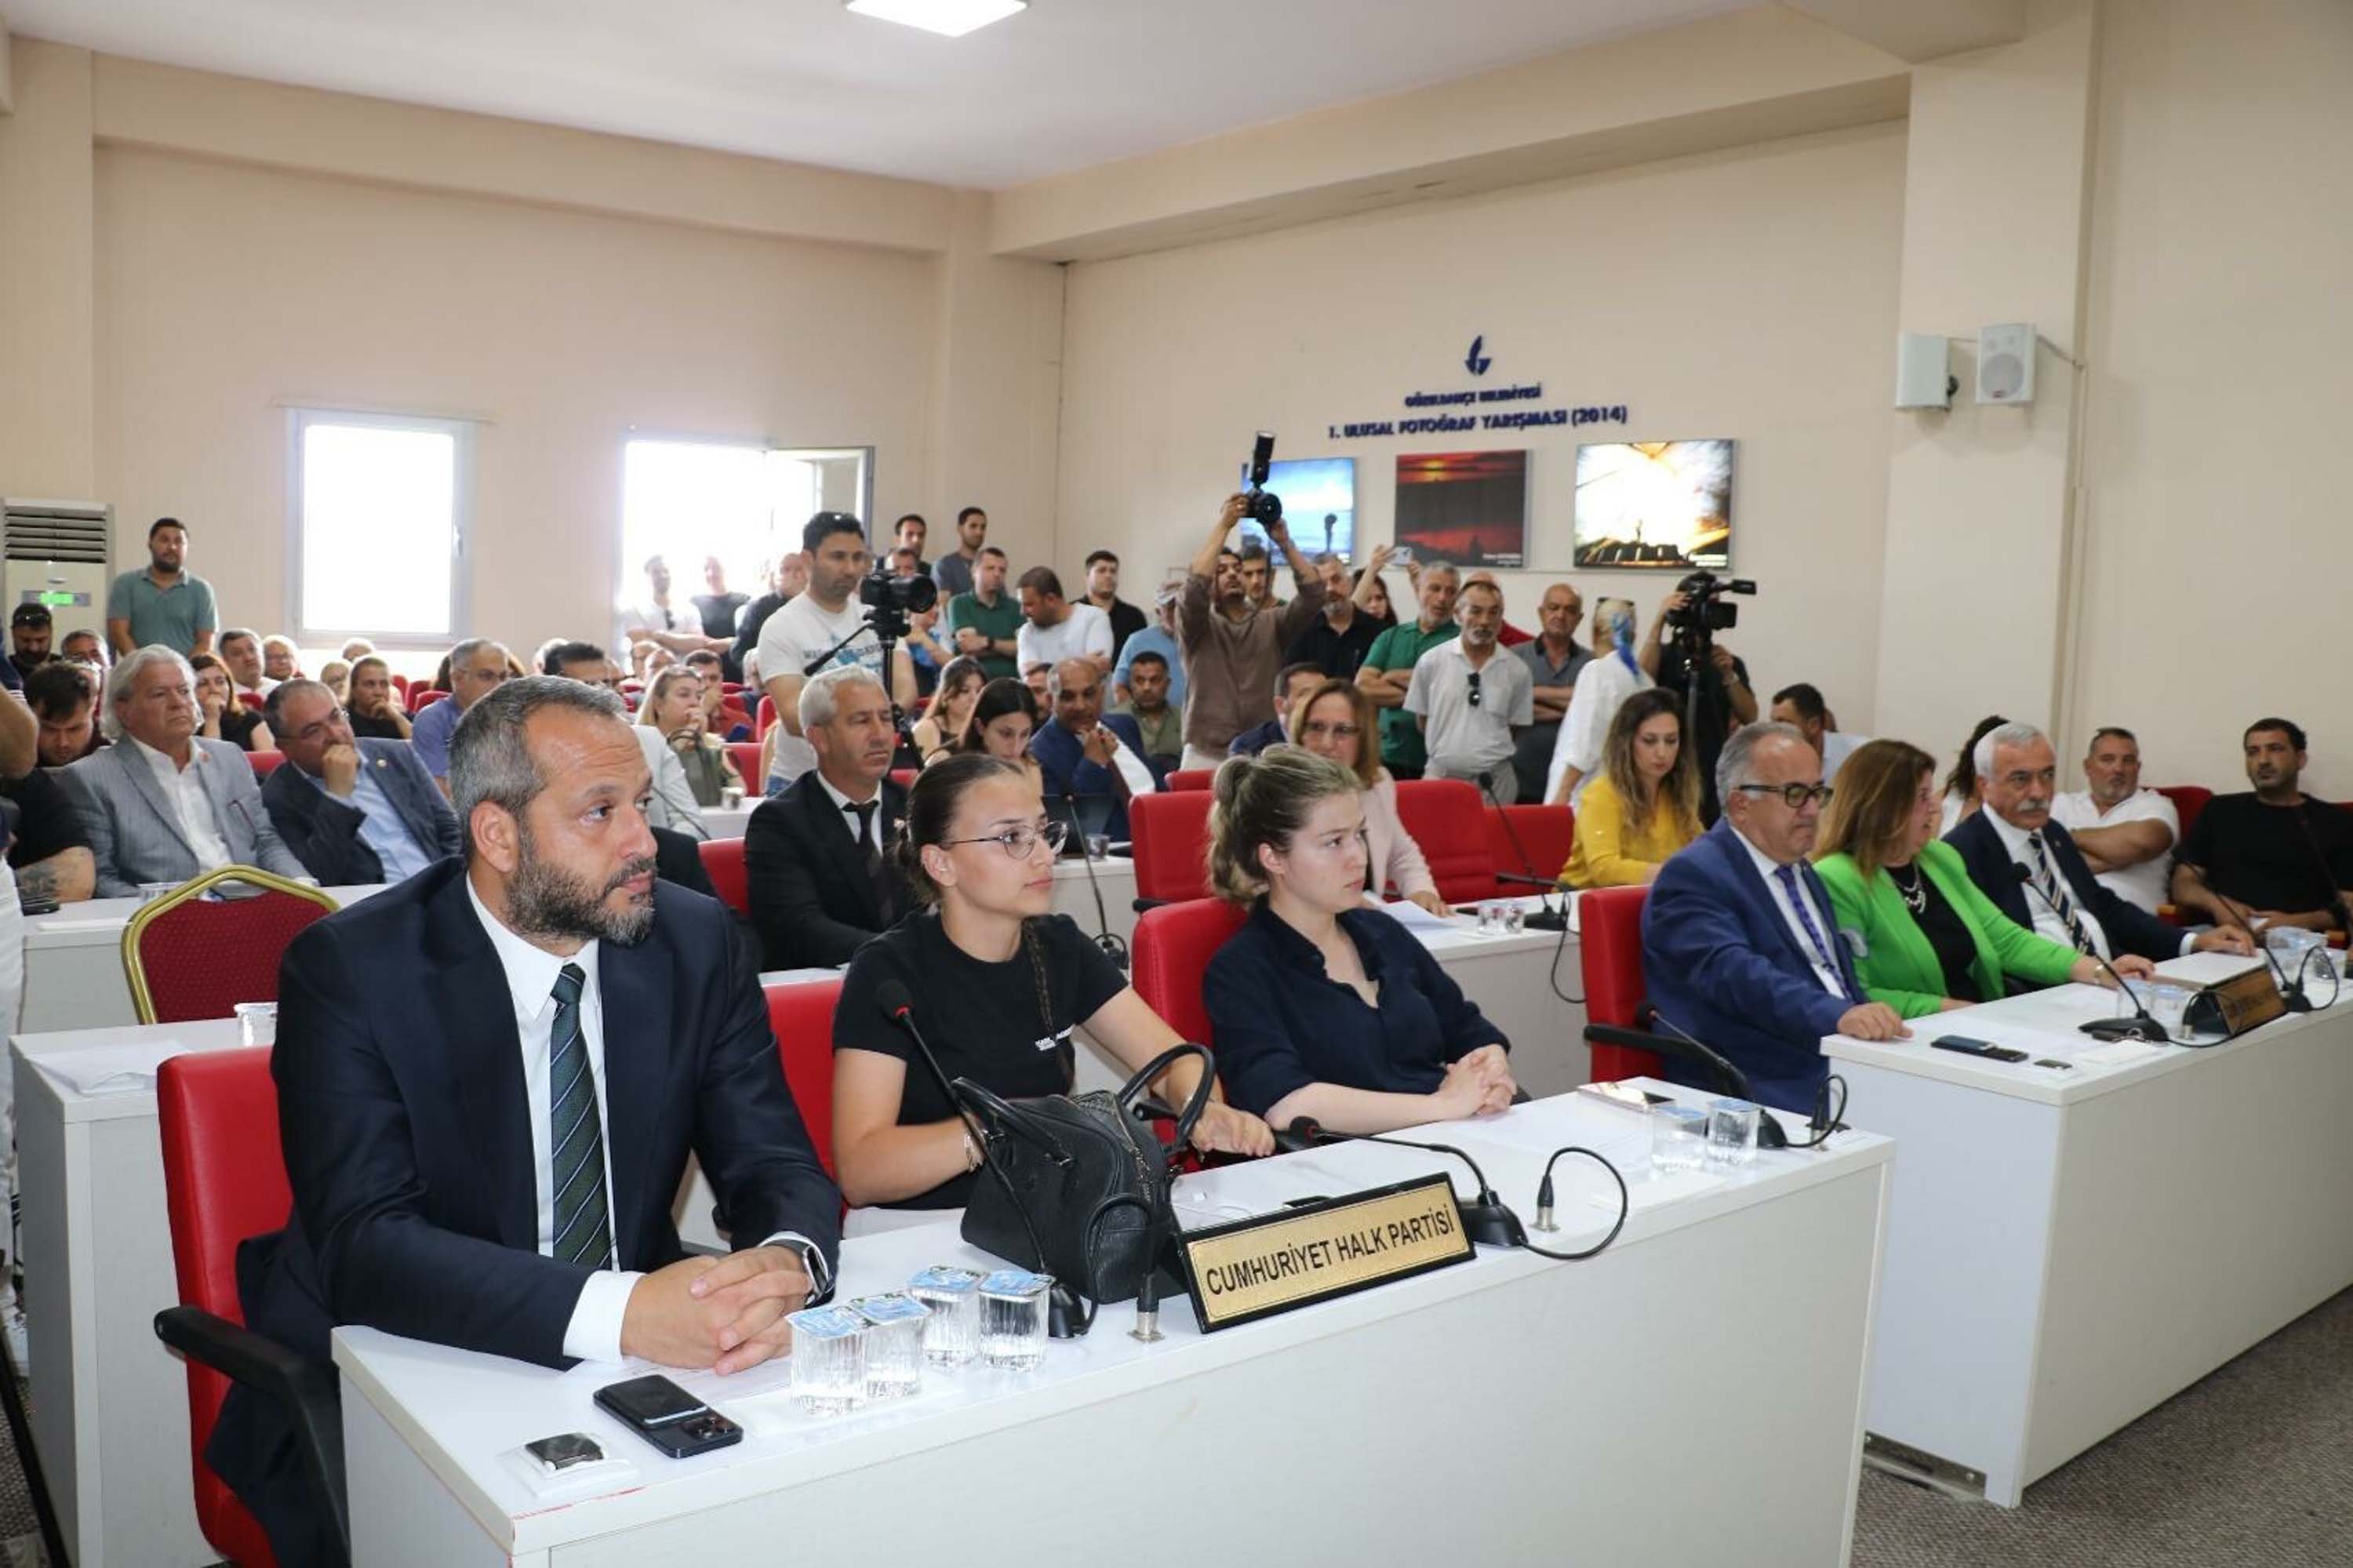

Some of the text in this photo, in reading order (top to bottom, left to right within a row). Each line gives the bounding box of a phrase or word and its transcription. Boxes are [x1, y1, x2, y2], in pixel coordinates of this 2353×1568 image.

[1344, 422, 1395, 437] ULUSAL
[1398, 413, 1476, 434] FOTOĞRAF
[1482, 409, 1567, 431] YARIŞMASI
[1571, 406, 1627, 427] (2014)
[1207, 1206, 1455, 1295] CUMHURİYET HALK PARTİSİ
